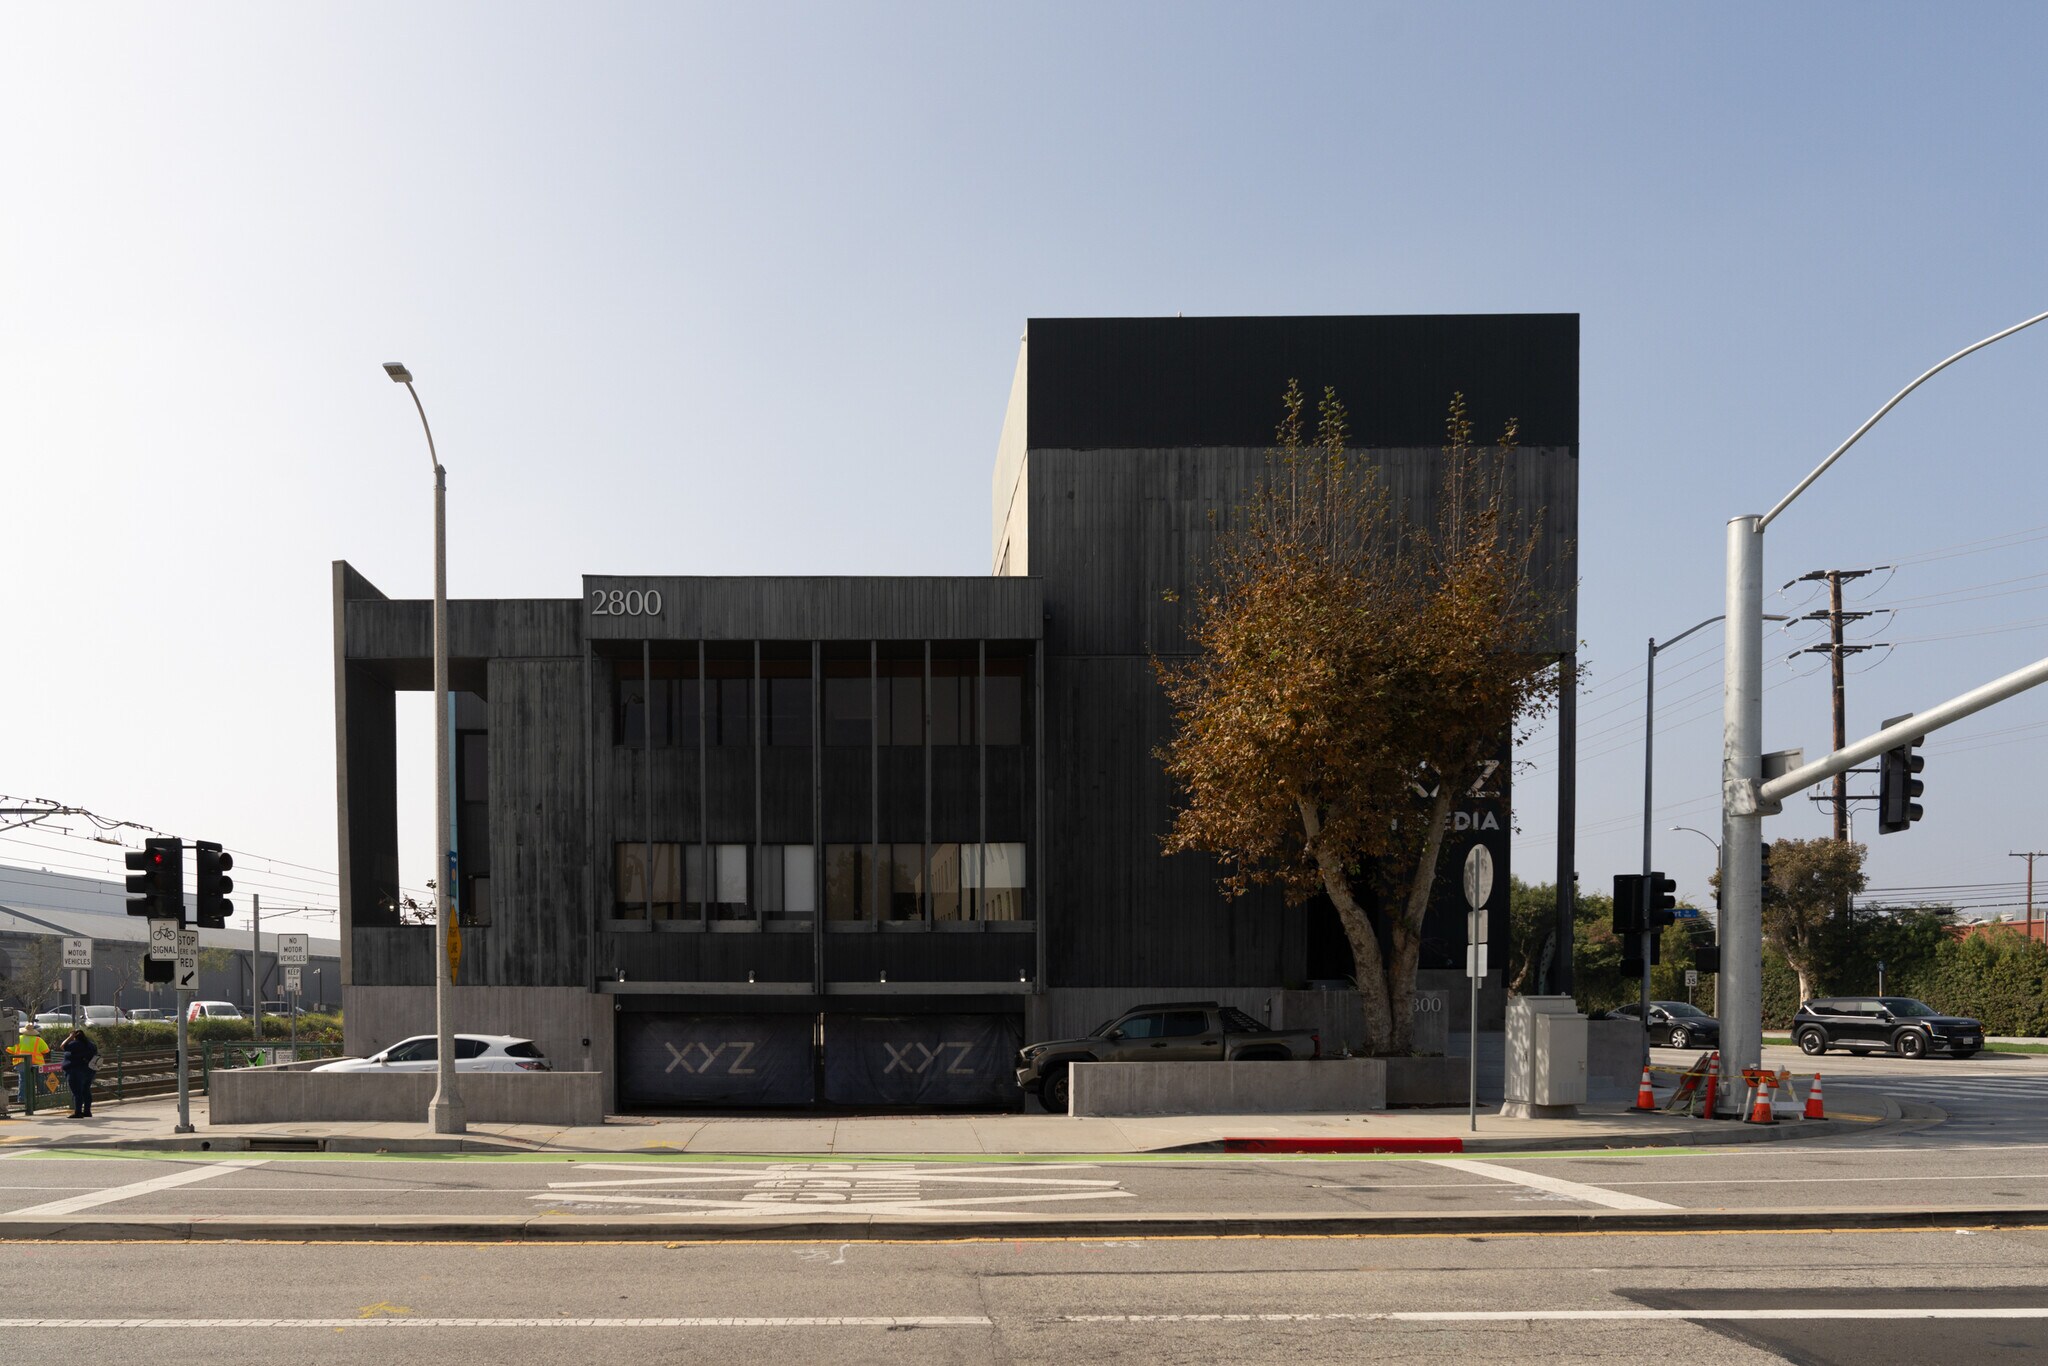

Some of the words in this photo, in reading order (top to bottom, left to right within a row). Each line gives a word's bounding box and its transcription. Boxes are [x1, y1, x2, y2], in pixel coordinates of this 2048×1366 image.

[591, 589, 662, 616] 2800
[178, 936, 196, 946] STOP
[68, 949, 87, 957] MOTOR
[152, 946, 177, 954] SIGNAL
[180, 957, 194, 968] RED
[1687, 977, 1696, 985] 35
[664, 1041, 756, 1074] XYZ
[882, 1041, 976, 1074] XYZ
